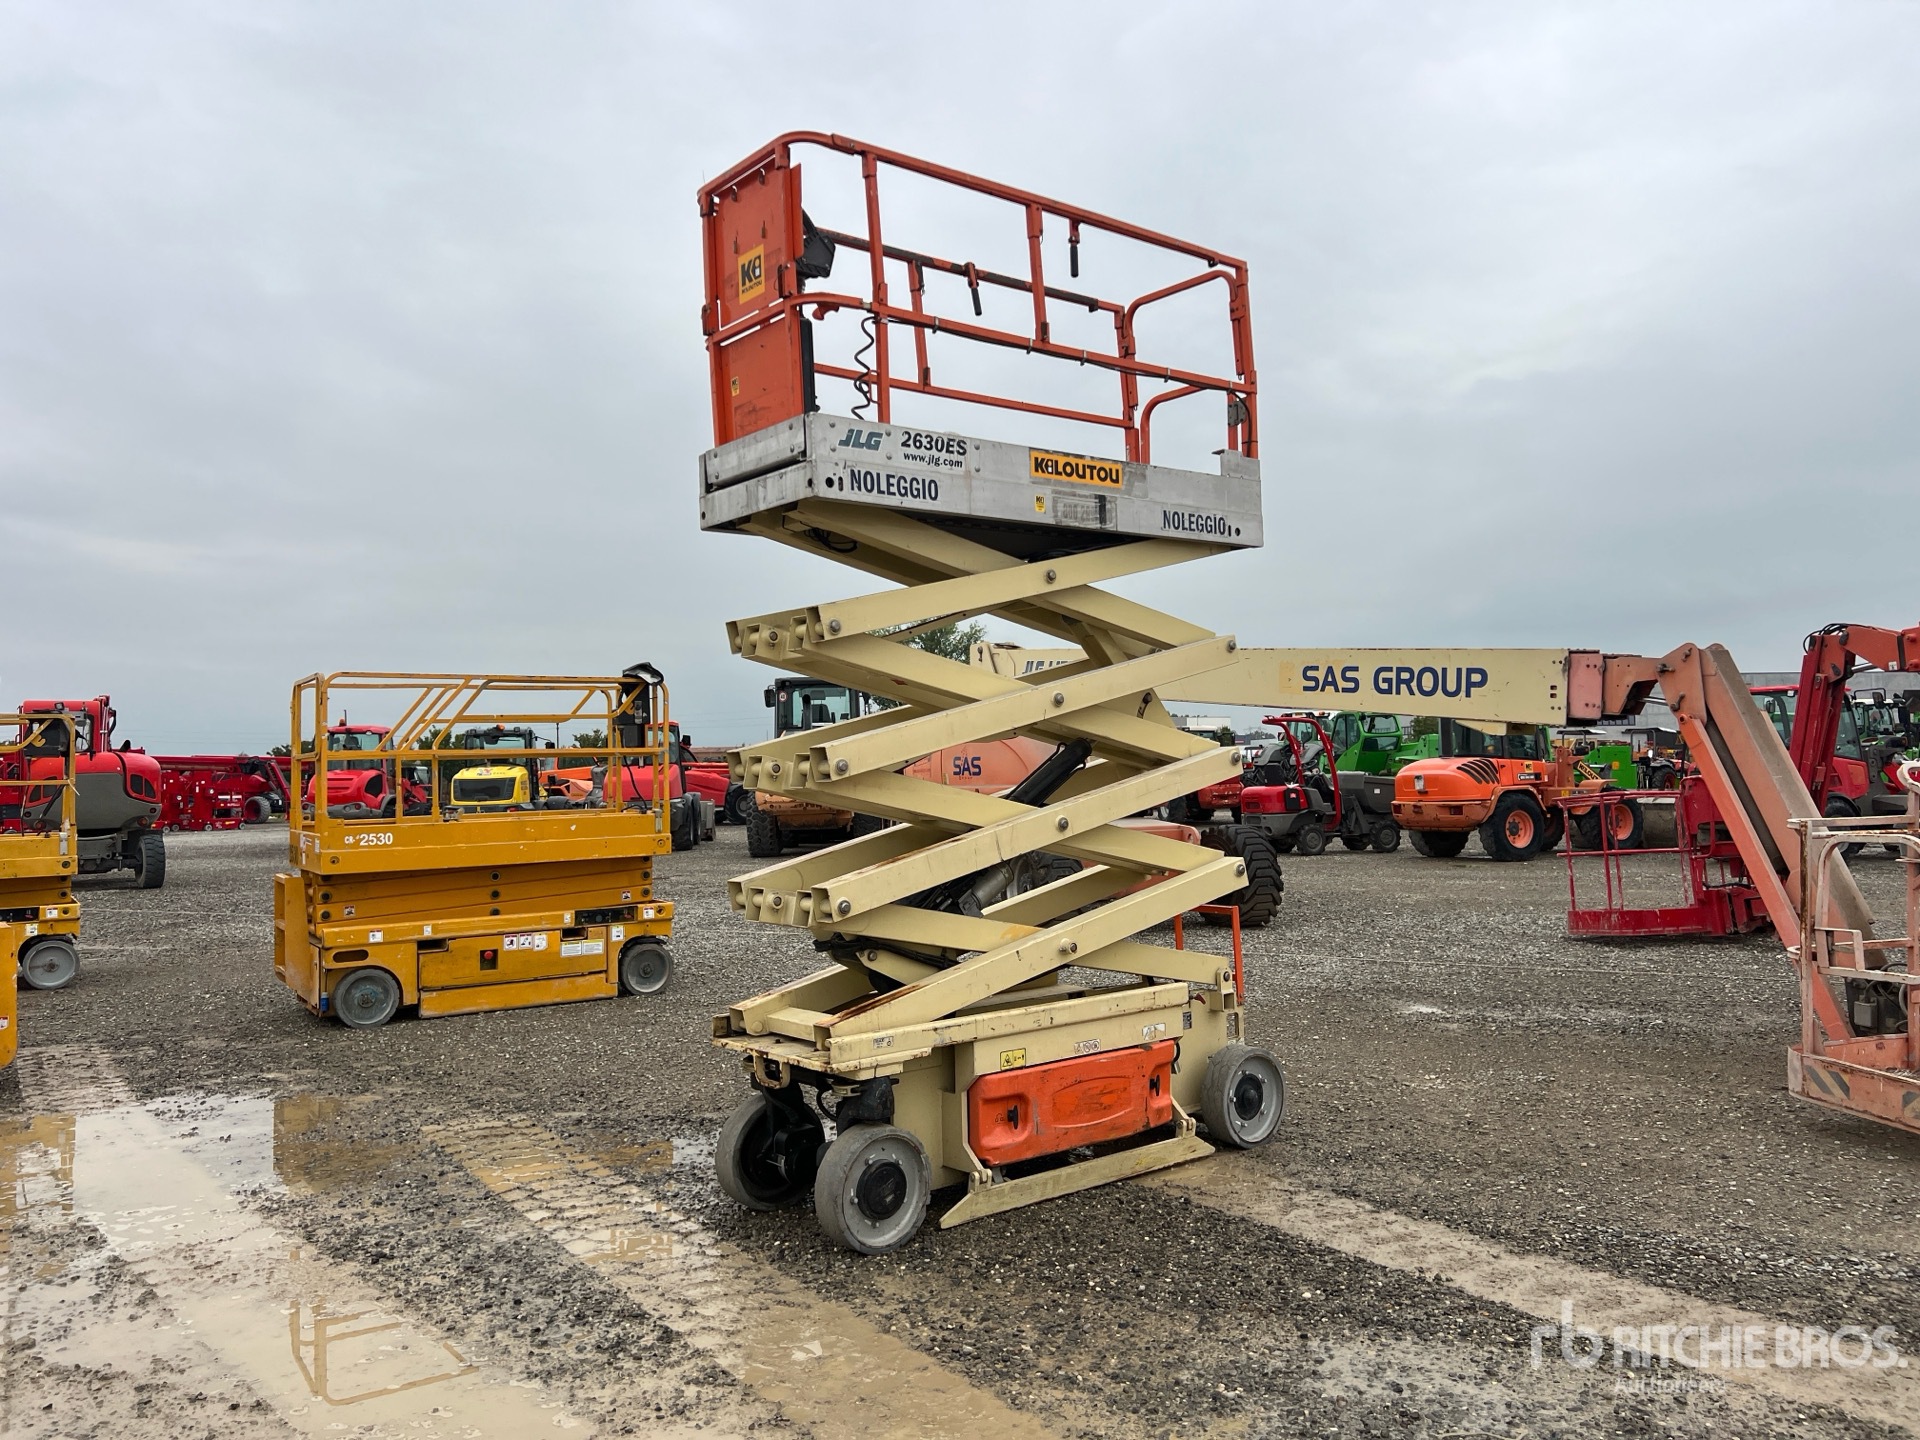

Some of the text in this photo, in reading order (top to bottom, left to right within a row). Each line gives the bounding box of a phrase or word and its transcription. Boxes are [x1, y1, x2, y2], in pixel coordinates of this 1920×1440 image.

[838, 428, 884, 451] JLG
[901, 431, 967, 456] 2630ES
[903, 452, 963, 468] www.jlg.com
[850, 468, 939, 501] NOLEGGIO
[1163, 510, 1226, 535] NOLEGGIO
[1302, 665, 1488, 698] SAS GROUP
[953, 756, 982, 776] SAS
[359, 832, 394, 846] 2530
